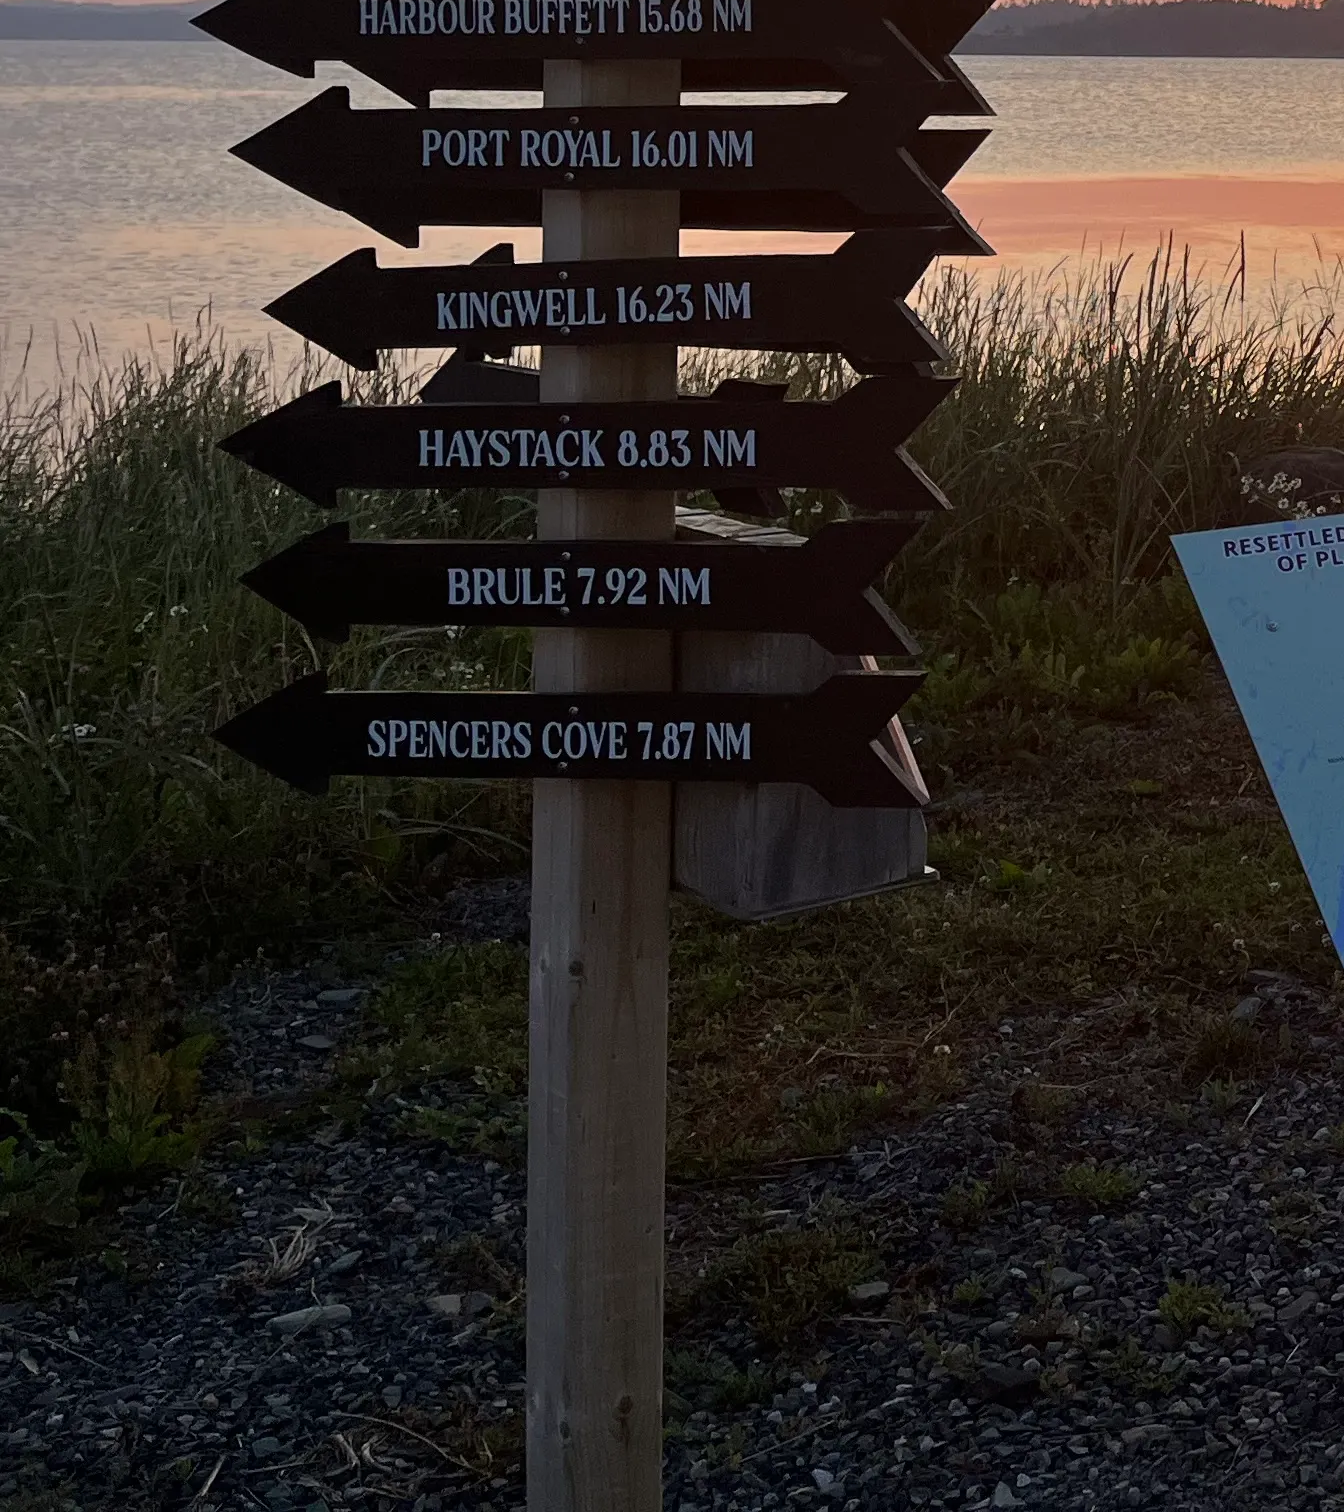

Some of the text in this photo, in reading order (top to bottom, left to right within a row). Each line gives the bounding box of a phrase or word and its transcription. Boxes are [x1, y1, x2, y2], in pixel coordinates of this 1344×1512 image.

[422, 129, 753, 168] PORT ROYAL 16.01 NM
[436, 281, 751, 330] KINGWELL 16.23 NM
[418, 429, 756, 468] HAYSTACK 8.83 NM
[1277, 554, 1308, 572] OF
[447, 567, 711, 606] BRULE 7.92 NM
[367, 719, 751, 761] SPENCERS COVE 7.87 NM
